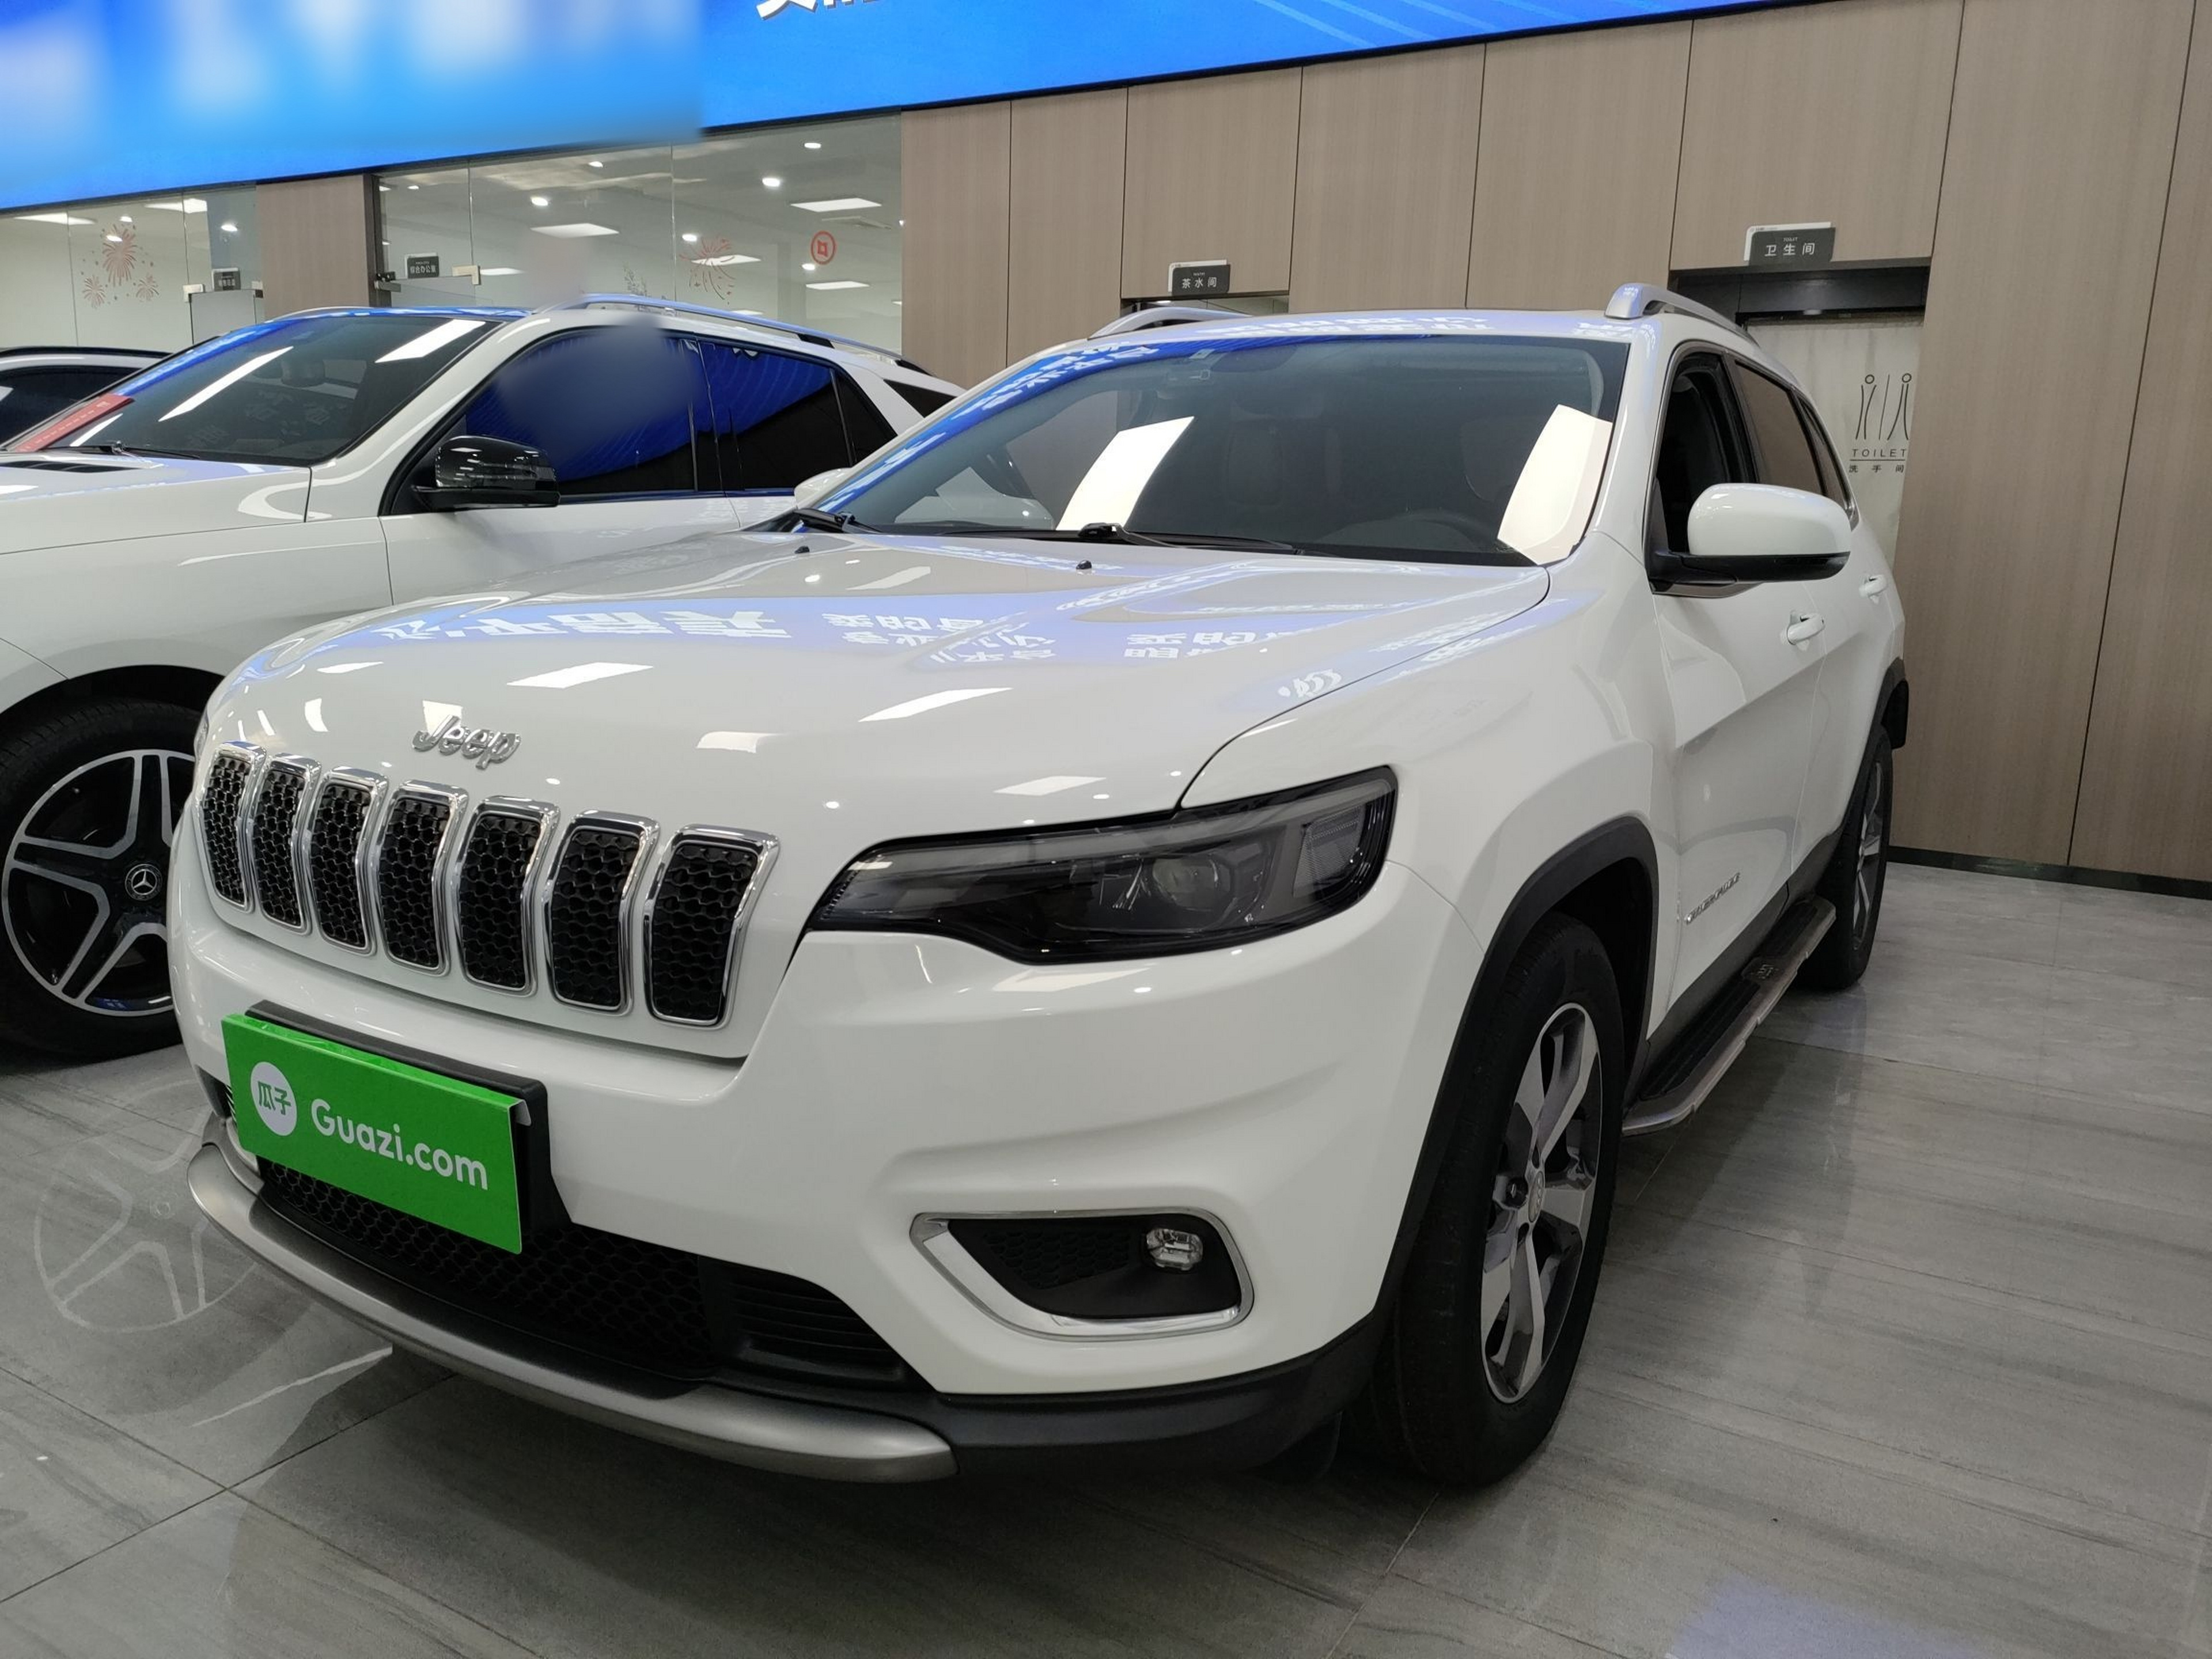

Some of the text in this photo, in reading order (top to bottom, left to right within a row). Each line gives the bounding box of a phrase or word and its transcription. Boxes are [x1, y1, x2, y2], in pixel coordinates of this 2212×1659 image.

[1764, 243, 1815, 257] 卫生间
[1182, 277, 1217, 289] 茶水间
[1852, 449, 1907, 457] TOILET
[1849, 464, 1904, 473] 洗手间
[412, 715, 521, 770] Jeep
[257, 1081, 488, 1190] 瓜子 Guazi.com
